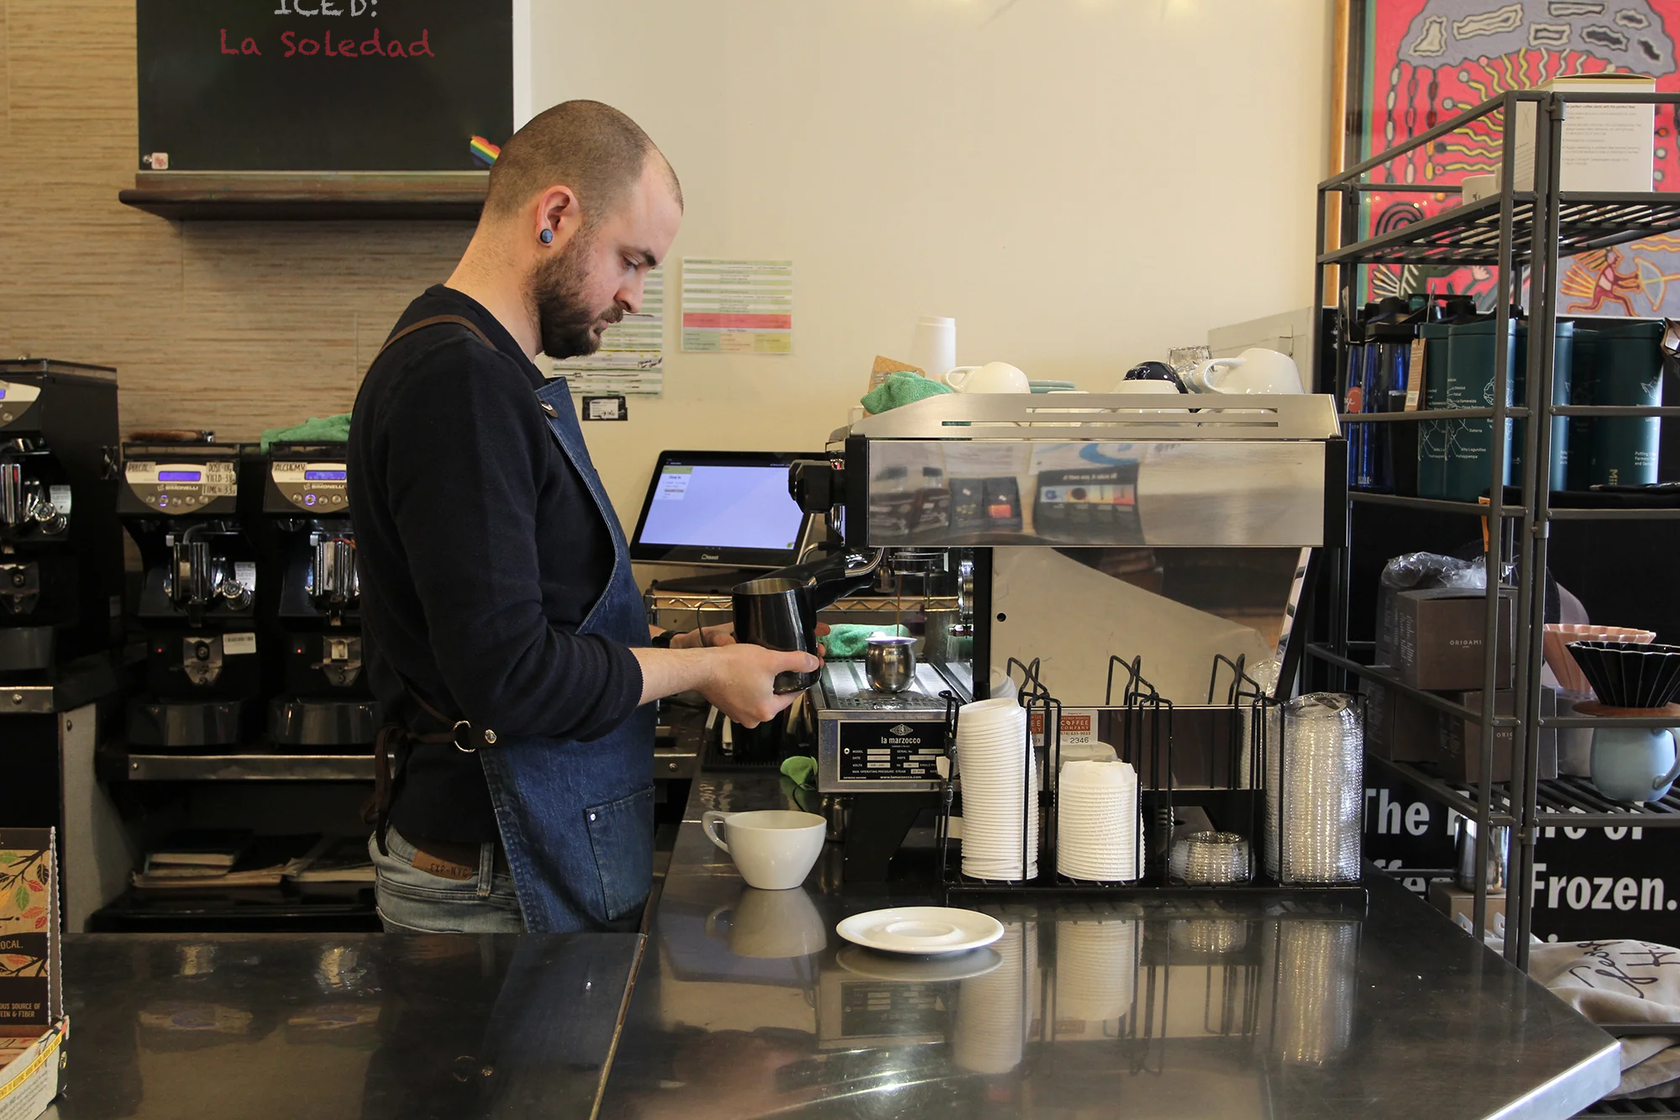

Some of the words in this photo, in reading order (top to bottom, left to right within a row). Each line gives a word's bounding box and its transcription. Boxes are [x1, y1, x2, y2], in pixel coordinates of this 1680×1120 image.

[274, 0, 378, 17] ICED:
[220, 28, 262, 56] La
[280, 28, 435, 58] Soledad
[881, 736, 888, 744] la
[1070, 736, 1089, 744] 2346
[1530, 862, 1678, 911] Frozen.
[0, 940, 23, 950] OCAL.
[11, 1002, 32, 1010] SOURCE
[18, 1010, 35, 1018] FIBER
